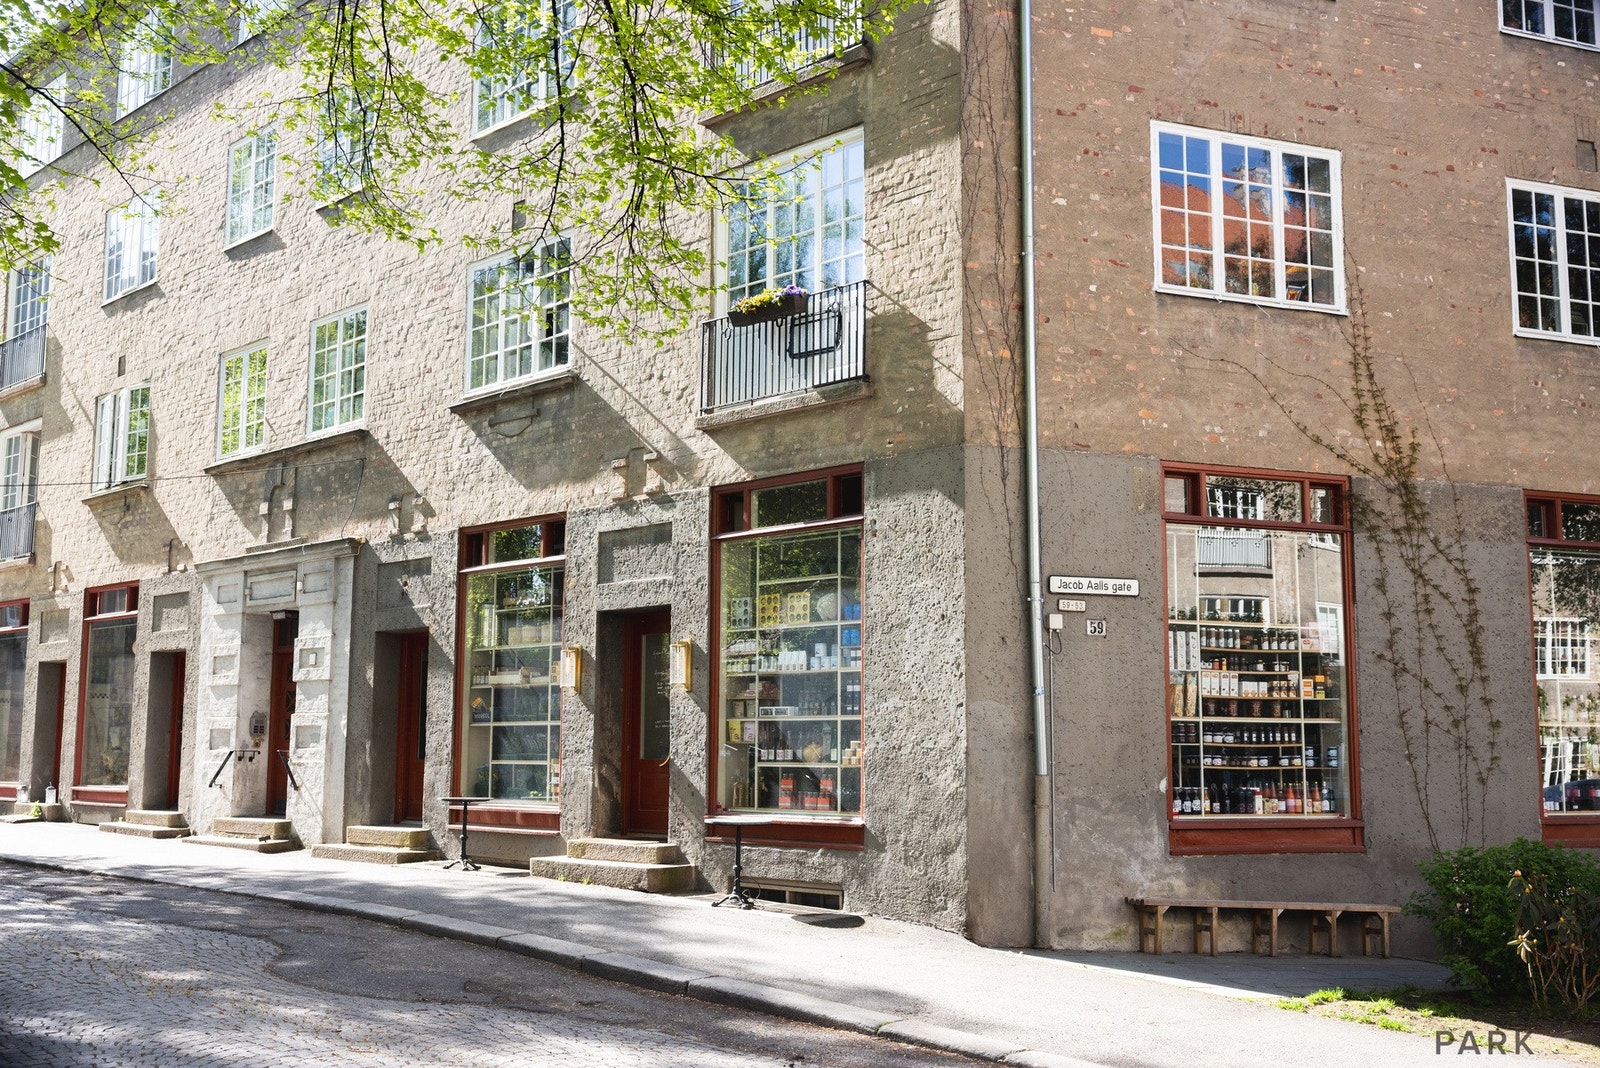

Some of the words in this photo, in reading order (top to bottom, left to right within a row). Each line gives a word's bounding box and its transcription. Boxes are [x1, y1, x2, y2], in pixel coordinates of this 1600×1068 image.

[1058, 578, 1084, 590] Jacob
[1086, 580, 1108, 590] Aalls
[1112, 582, 1132, 594] gate
[1090, 622, 1104, 634] 59
